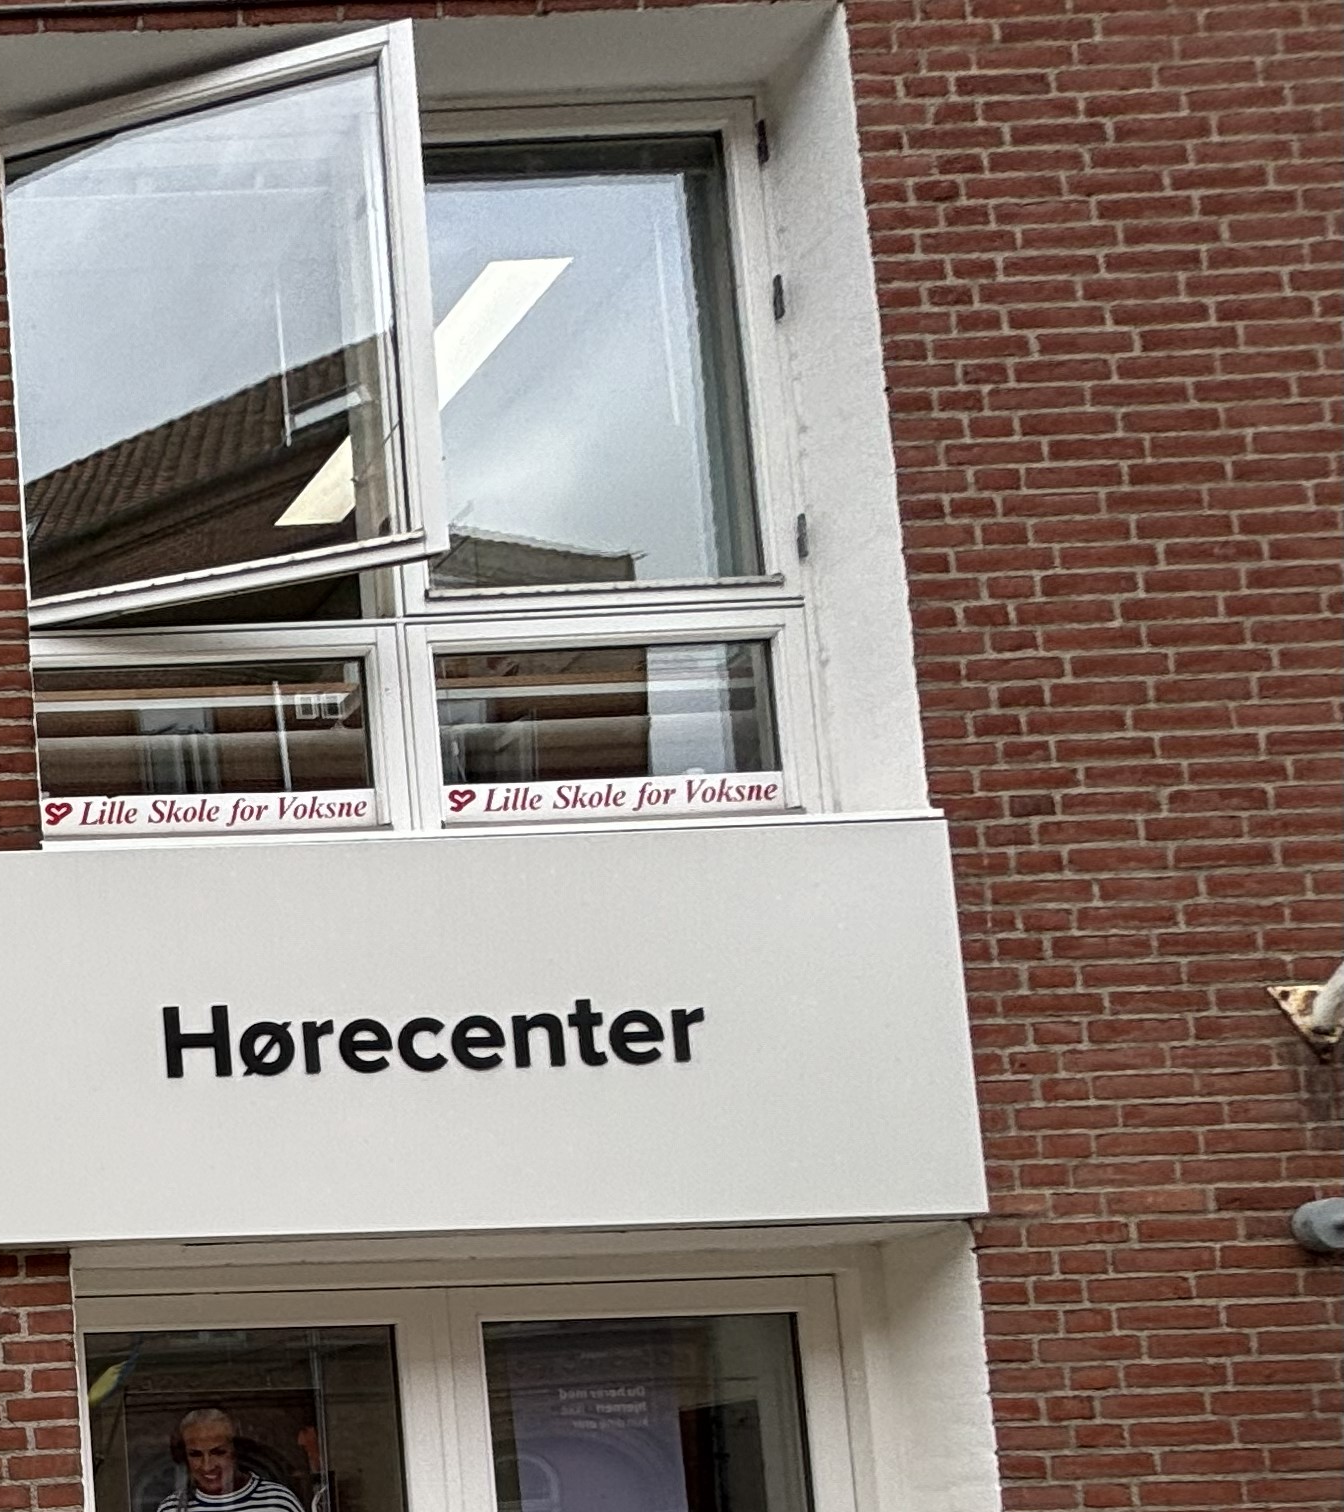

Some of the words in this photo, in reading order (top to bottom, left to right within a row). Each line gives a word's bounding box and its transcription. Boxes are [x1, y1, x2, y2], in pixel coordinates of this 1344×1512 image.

[78, 800, 138, 826] Lille
[147, 798, 220, 824] Skole
[226, 797, 269, 827] for
[277, 796, 368, 820] Voksne
[484, 787, 543, 812] Lille
[552, 783, 626, 810] Skole
[632, 782, 676, 812] for
[685, 778, 778, 804] Voksne
[162, 998, 705, 1079] Hørecenter
